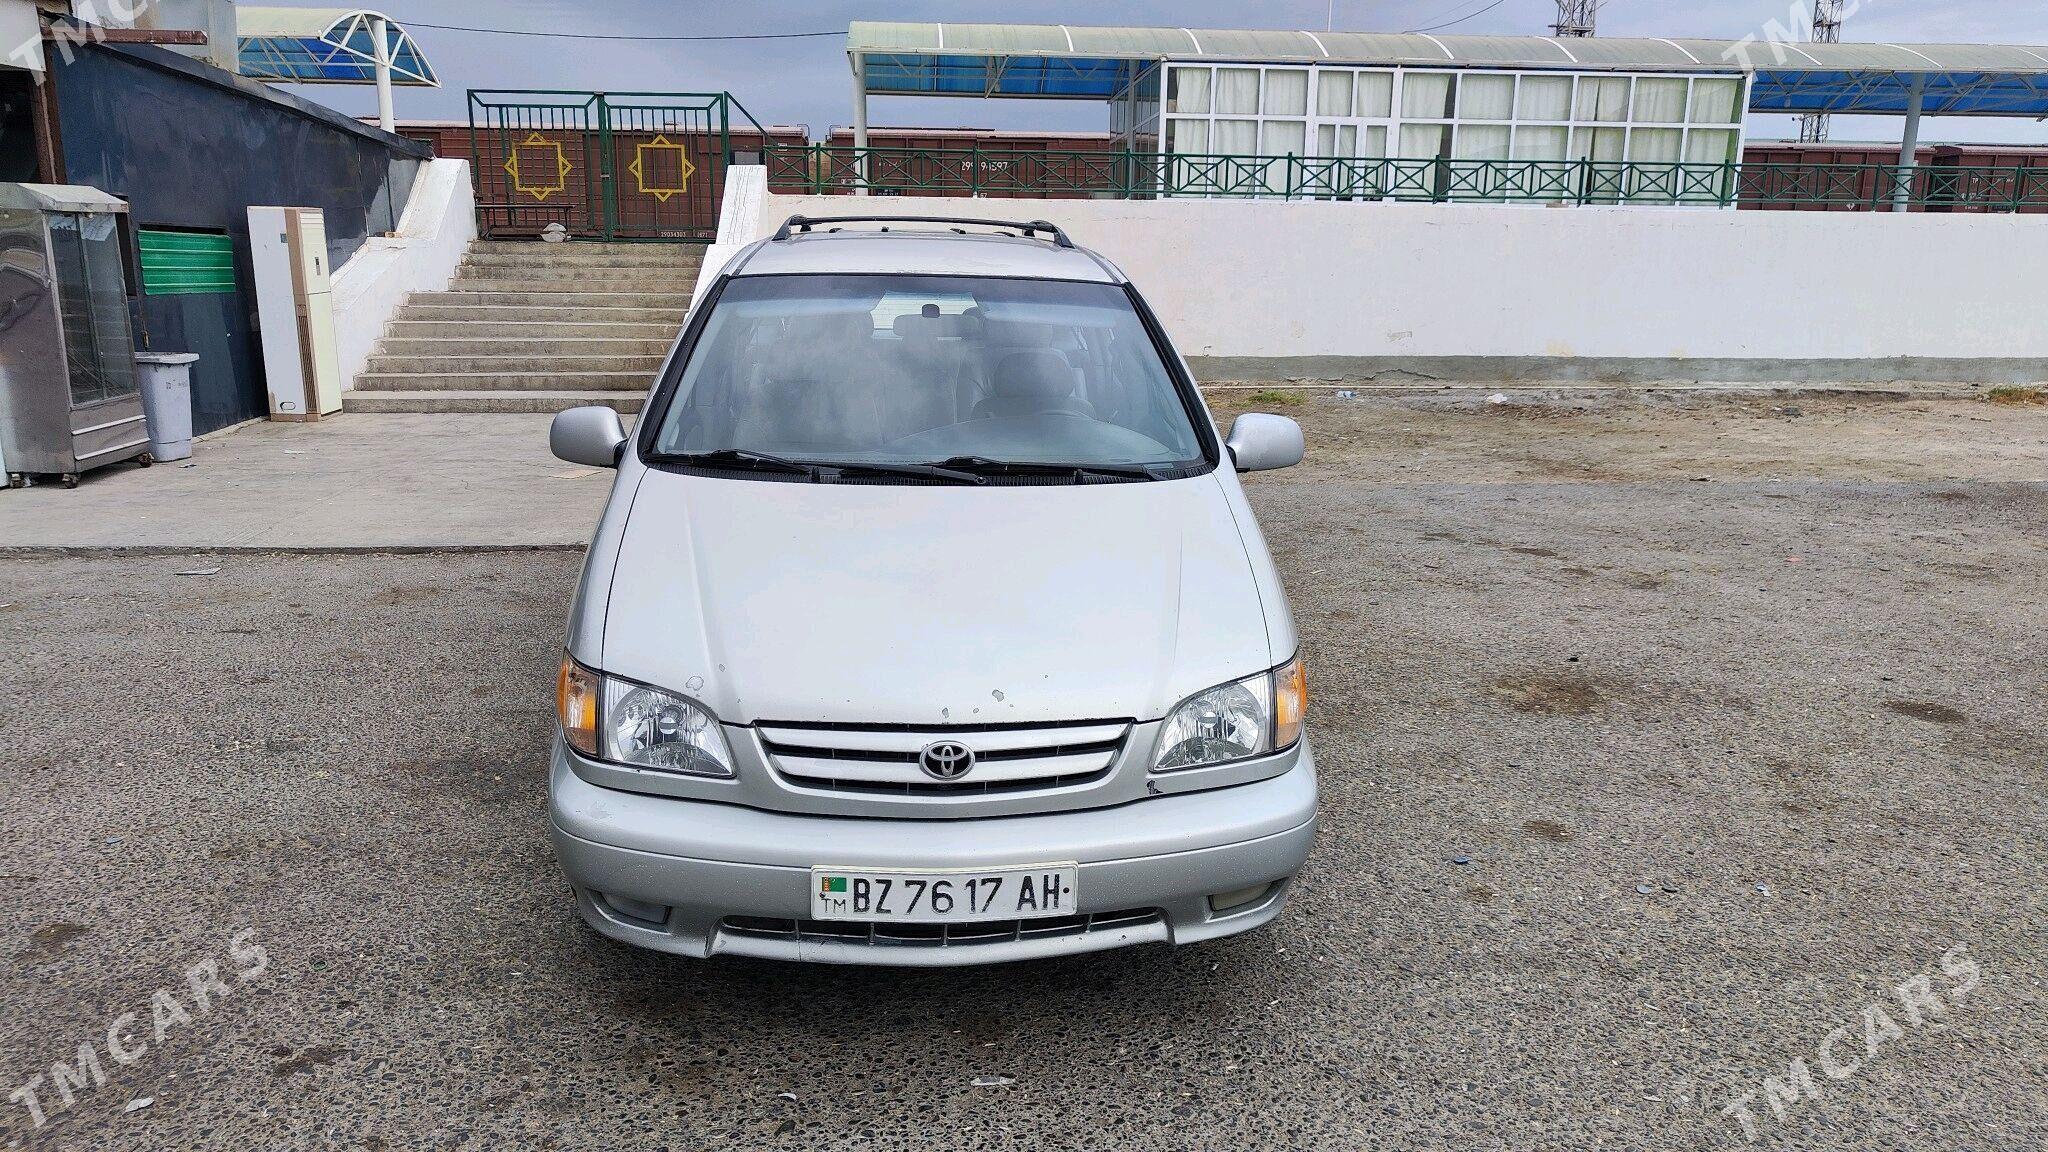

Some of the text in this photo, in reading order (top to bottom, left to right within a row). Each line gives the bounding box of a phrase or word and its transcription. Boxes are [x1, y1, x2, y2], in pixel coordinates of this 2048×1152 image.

[822, 898, 847, 914] TM
[853, 873, 1060, 914] BZ 76 17 AH
